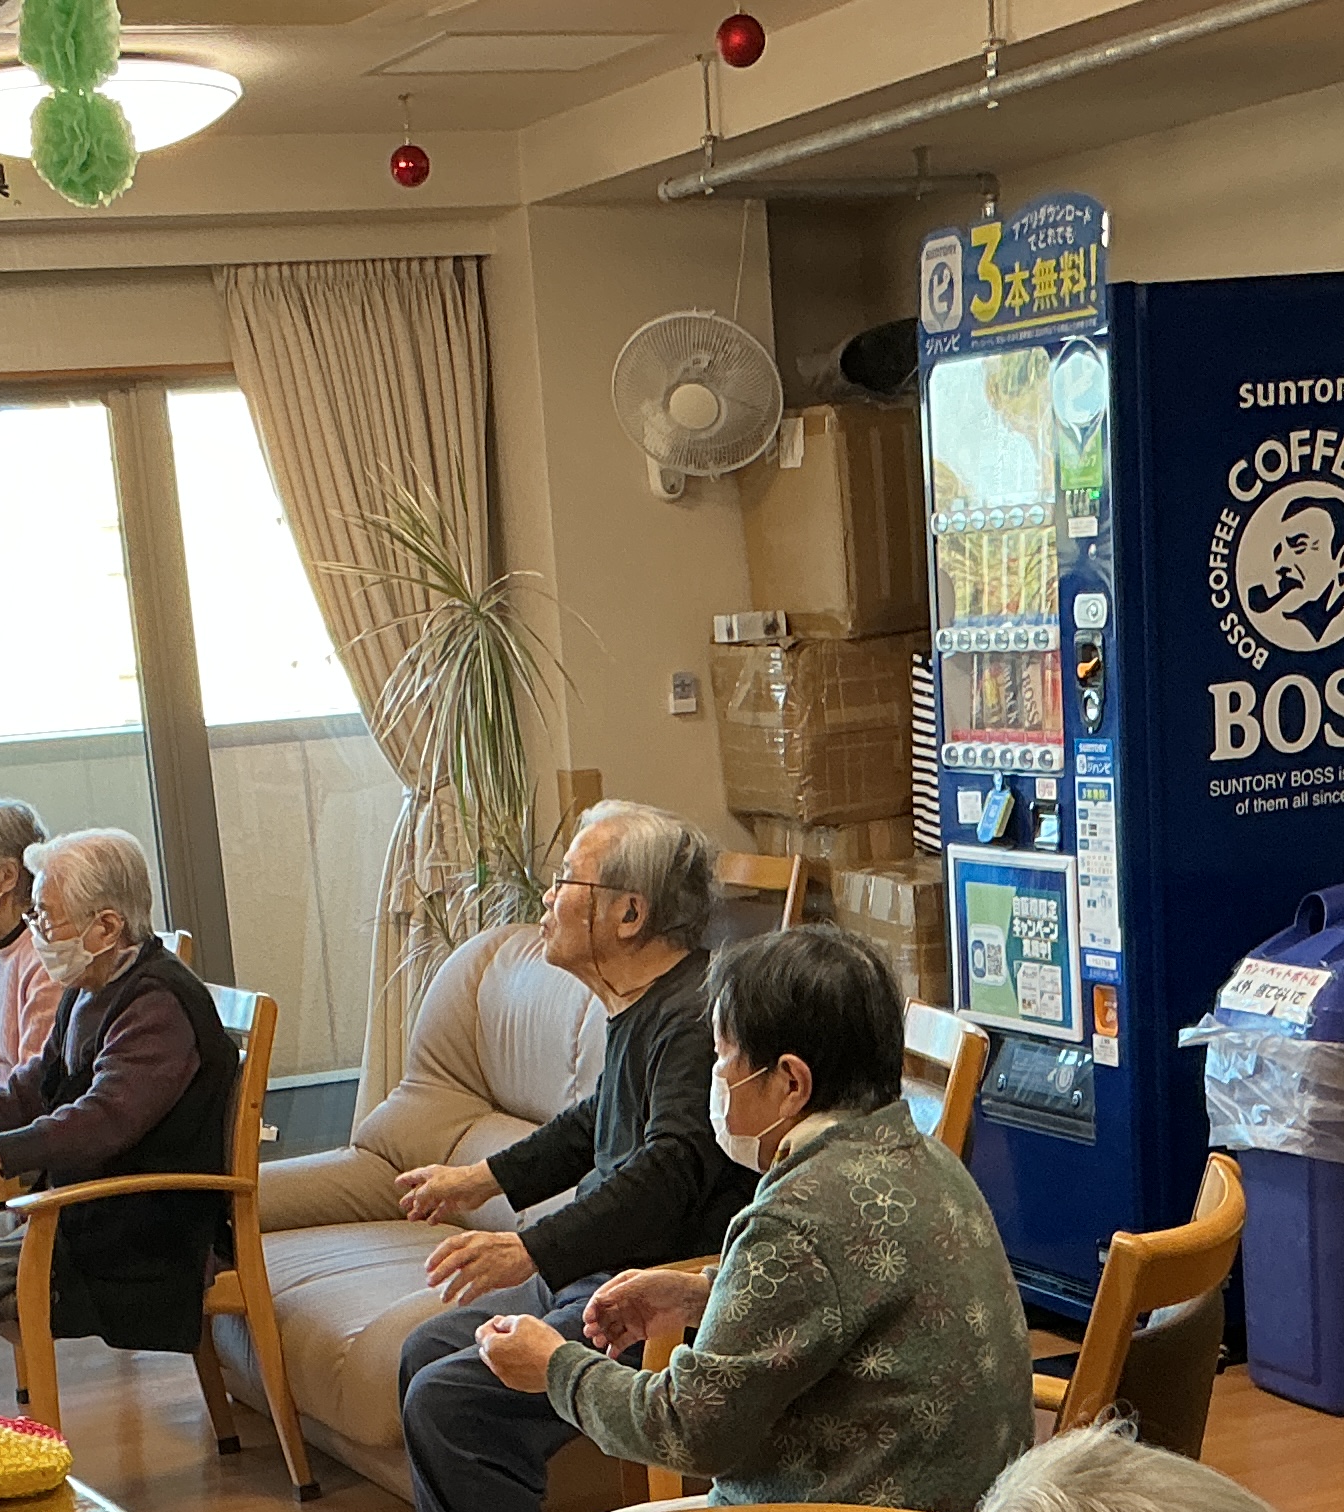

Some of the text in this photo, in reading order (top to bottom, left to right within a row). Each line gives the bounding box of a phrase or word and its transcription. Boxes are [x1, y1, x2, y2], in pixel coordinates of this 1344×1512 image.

[1209, 507, 1270, 670] BOSS COFFEE
[1209, 772, 1286, 797] SUNTORY
[1291, 767, 1335, 787] BOSS
[1235, 800, 1249, 816] of
[1253, 797, 1289, 814] them
[1292, 792, 1308, 809] all
